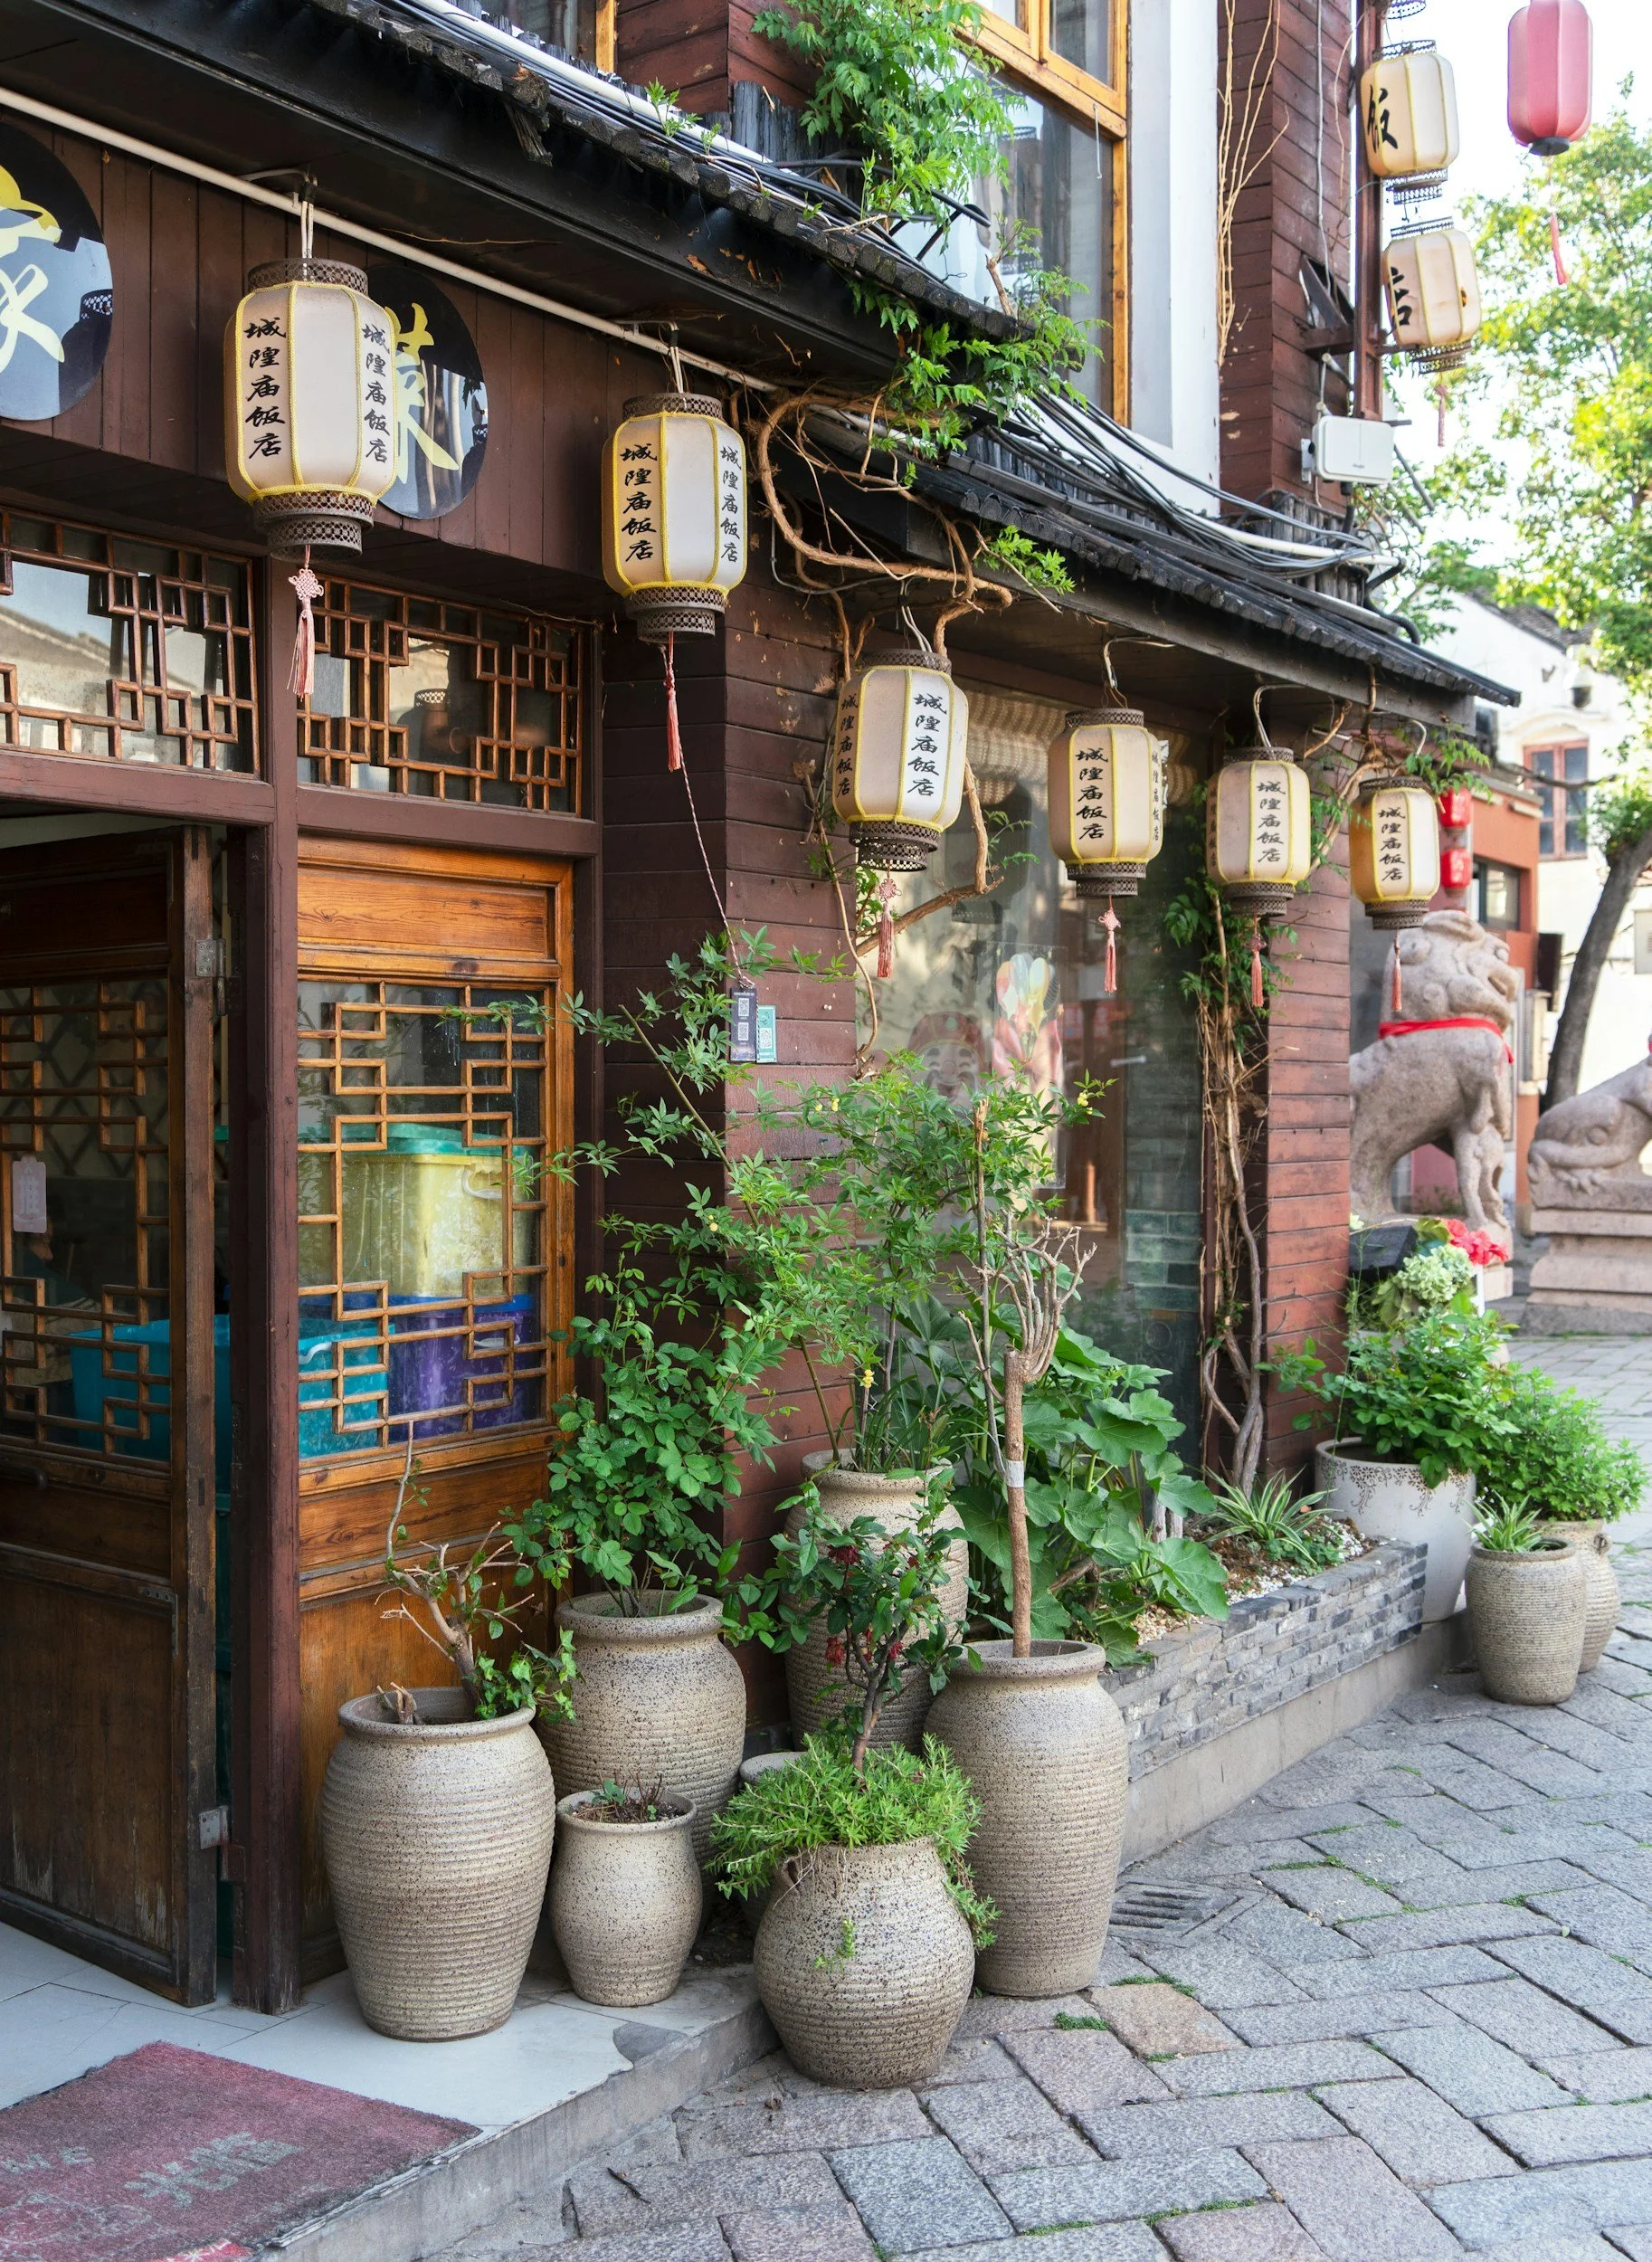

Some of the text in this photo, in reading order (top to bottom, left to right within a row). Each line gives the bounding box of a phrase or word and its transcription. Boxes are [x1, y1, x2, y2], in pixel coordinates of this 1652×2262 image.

[244, 317, 286, 460] 城隍庙饭店
[361, 323, 391, 464] 城隍庙饭店
[619, 443, 658, 563] 城隍庙饭店
[720, 445, 743, 564] 城隍庙饭店
[908, 693, 947, 797] 城隍庙饭店
[1075, 747, 1108, 841] 城隍庙饭店
[1257, 781, 1286, 863] 城隍庙饭店
[1378, 806, 1407, 881] 城隍庙饭店
